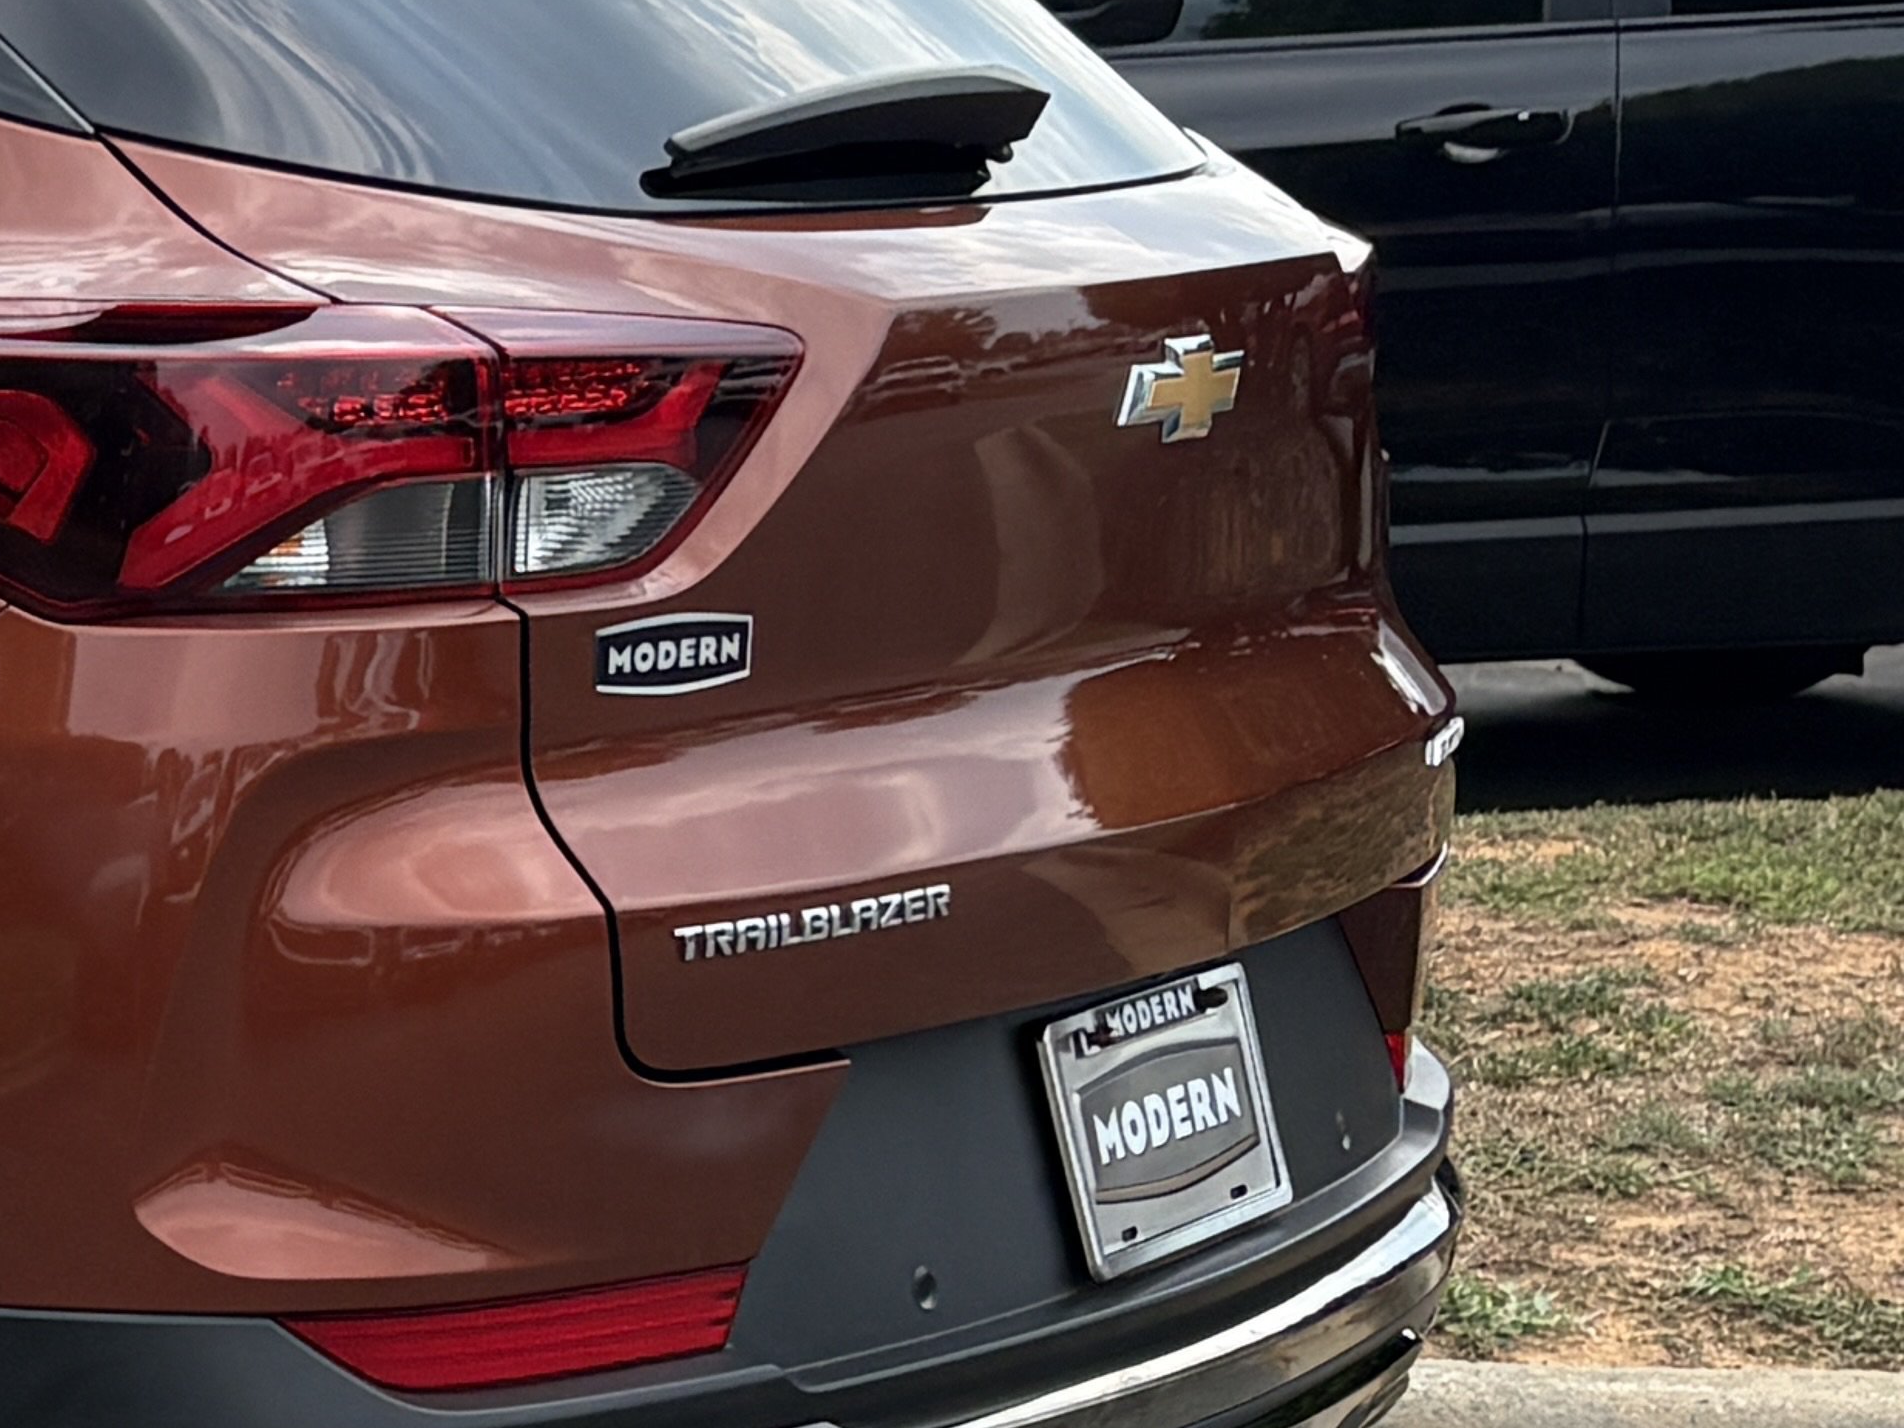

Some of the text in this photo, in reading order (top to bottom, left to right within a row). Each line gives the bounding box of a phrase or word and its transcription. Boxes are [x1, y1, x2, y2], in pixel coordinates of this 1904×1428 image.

[608, 632, 740, 675] MODERN
[673, 883, 951, 961] TRAILBLAZER
[1093, 1067, 1242, 1165] MODERN
